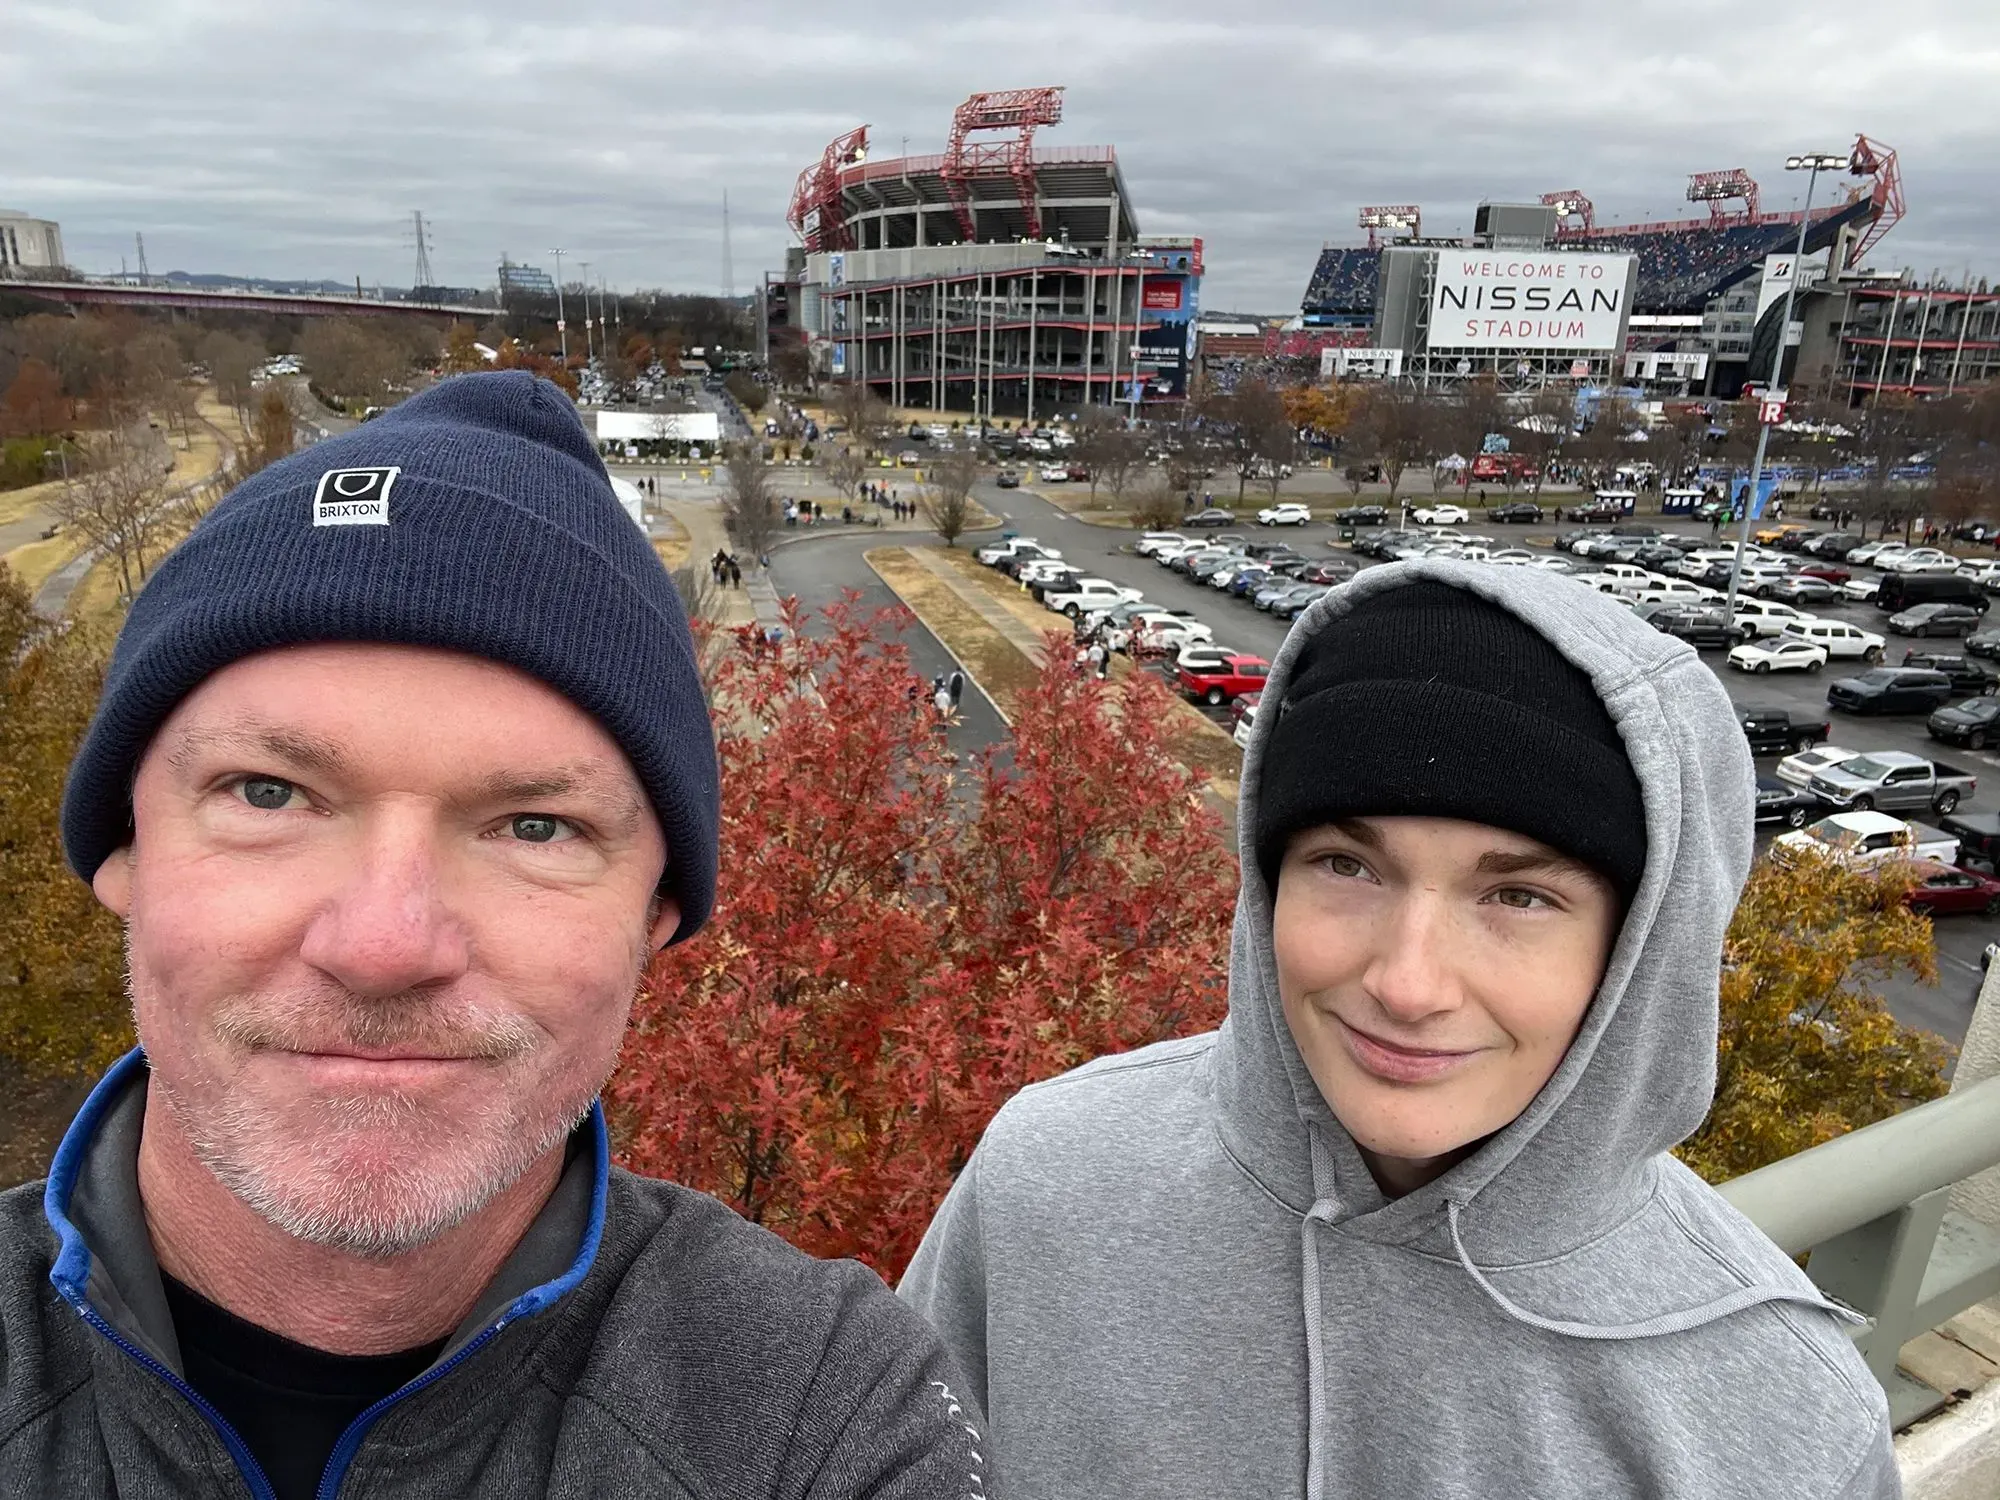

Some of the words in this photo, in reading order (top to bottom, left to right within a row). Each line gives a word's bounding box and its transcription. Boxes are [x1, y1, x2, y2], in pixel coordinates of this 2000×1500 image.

[1463, 262, 1566, 278] WELCOME
[1578, 265, 1603, 279] TO
[1439, 285, 1619, 312] NISSAN
[1465, 320, 1584, 338] STADIUM
[1349, 350, 1394, 358] NISSAN
[1659, 353, 1700, 361] NISSAN
[1764, 402, 1782, 422] R
[319, 504, 380, 518] BRIXTON
